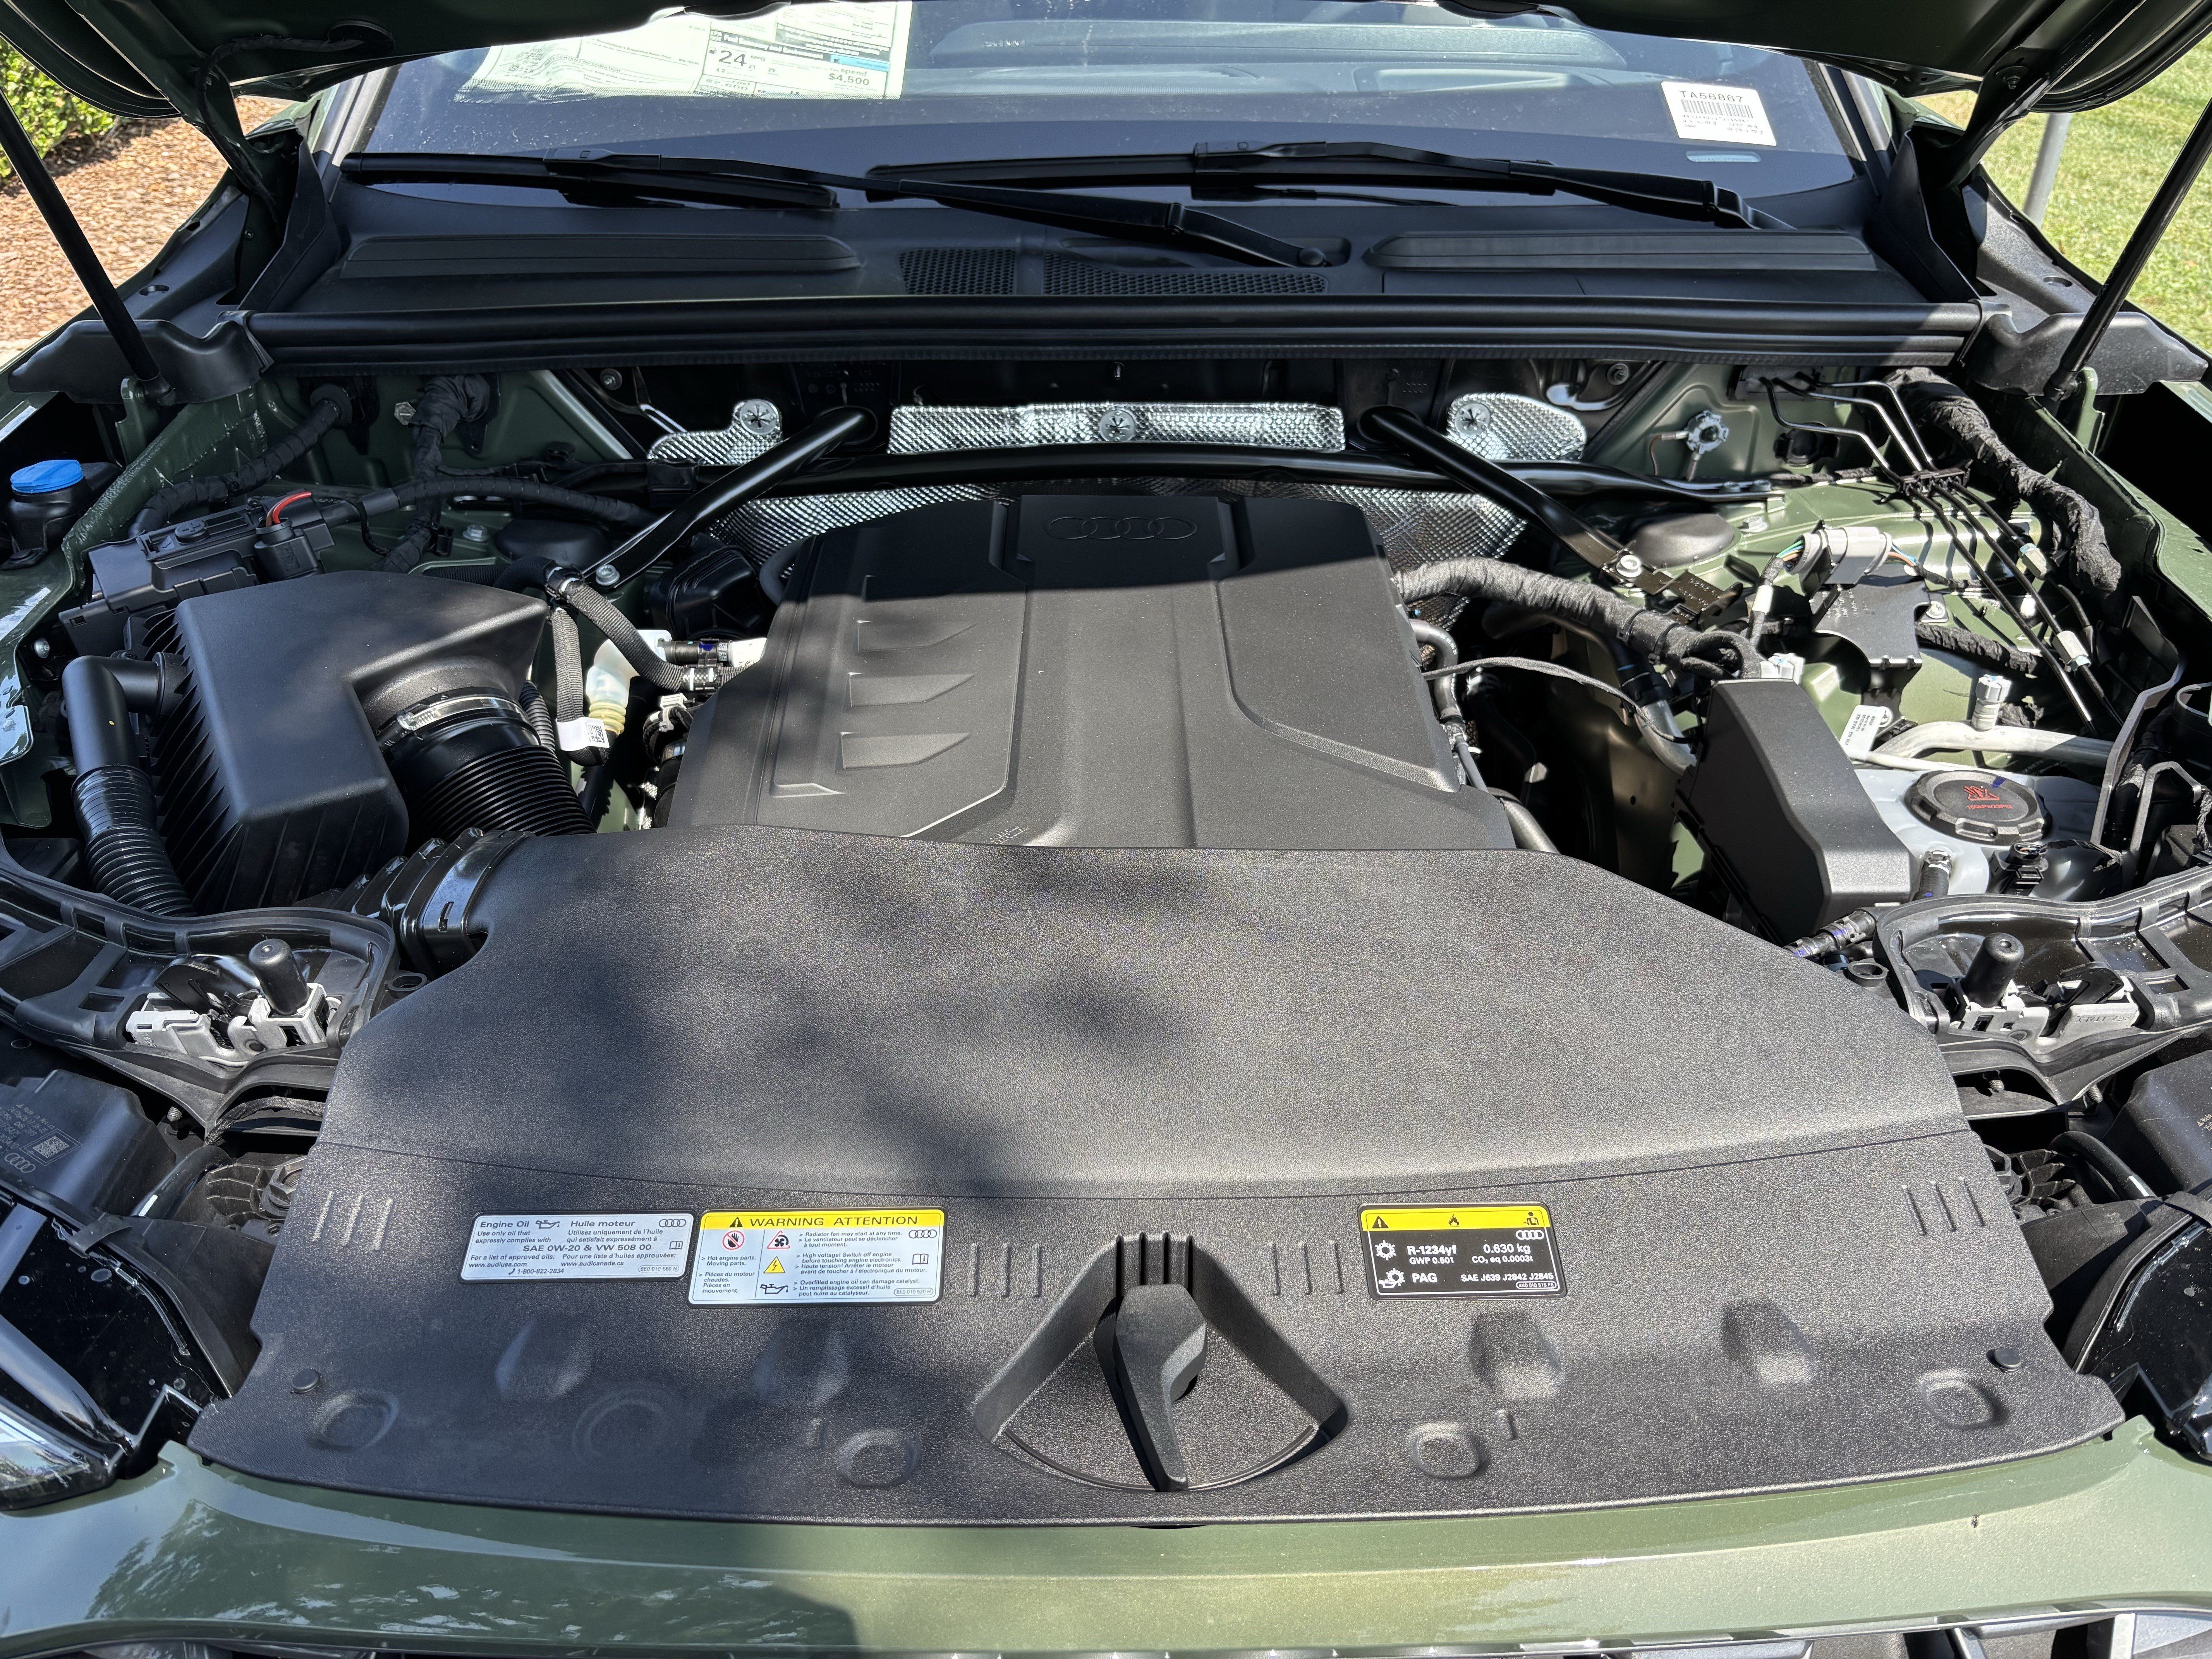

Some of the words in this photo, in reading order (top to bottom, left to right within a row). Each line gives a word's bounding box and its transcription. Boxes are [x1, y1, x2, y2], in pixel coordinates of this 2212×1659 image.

[718, 50, 747, 67] 24
[841, 68, 867, 77] spend
[828, 72, 870, 86] $4,500
[1679, 90, 1743, 103] TA56867
[750, 1218, 824, 1226] WARNING
[833, 1216, 917, 1225] ATTENTION
[1407, 1244, 1457, 1256] R-1234yf
[1483, 1243, 1514, 1255] 0.630
[1515, 1242, 1531, 1255] kg
[1409, 1257, 1431, 1265] GWP
[1432, 1256, 1455, 1264] 0.501
[1412, 1272, 1438, 1283] PAG
[1460, 1274, 1479, 1282] SAE
